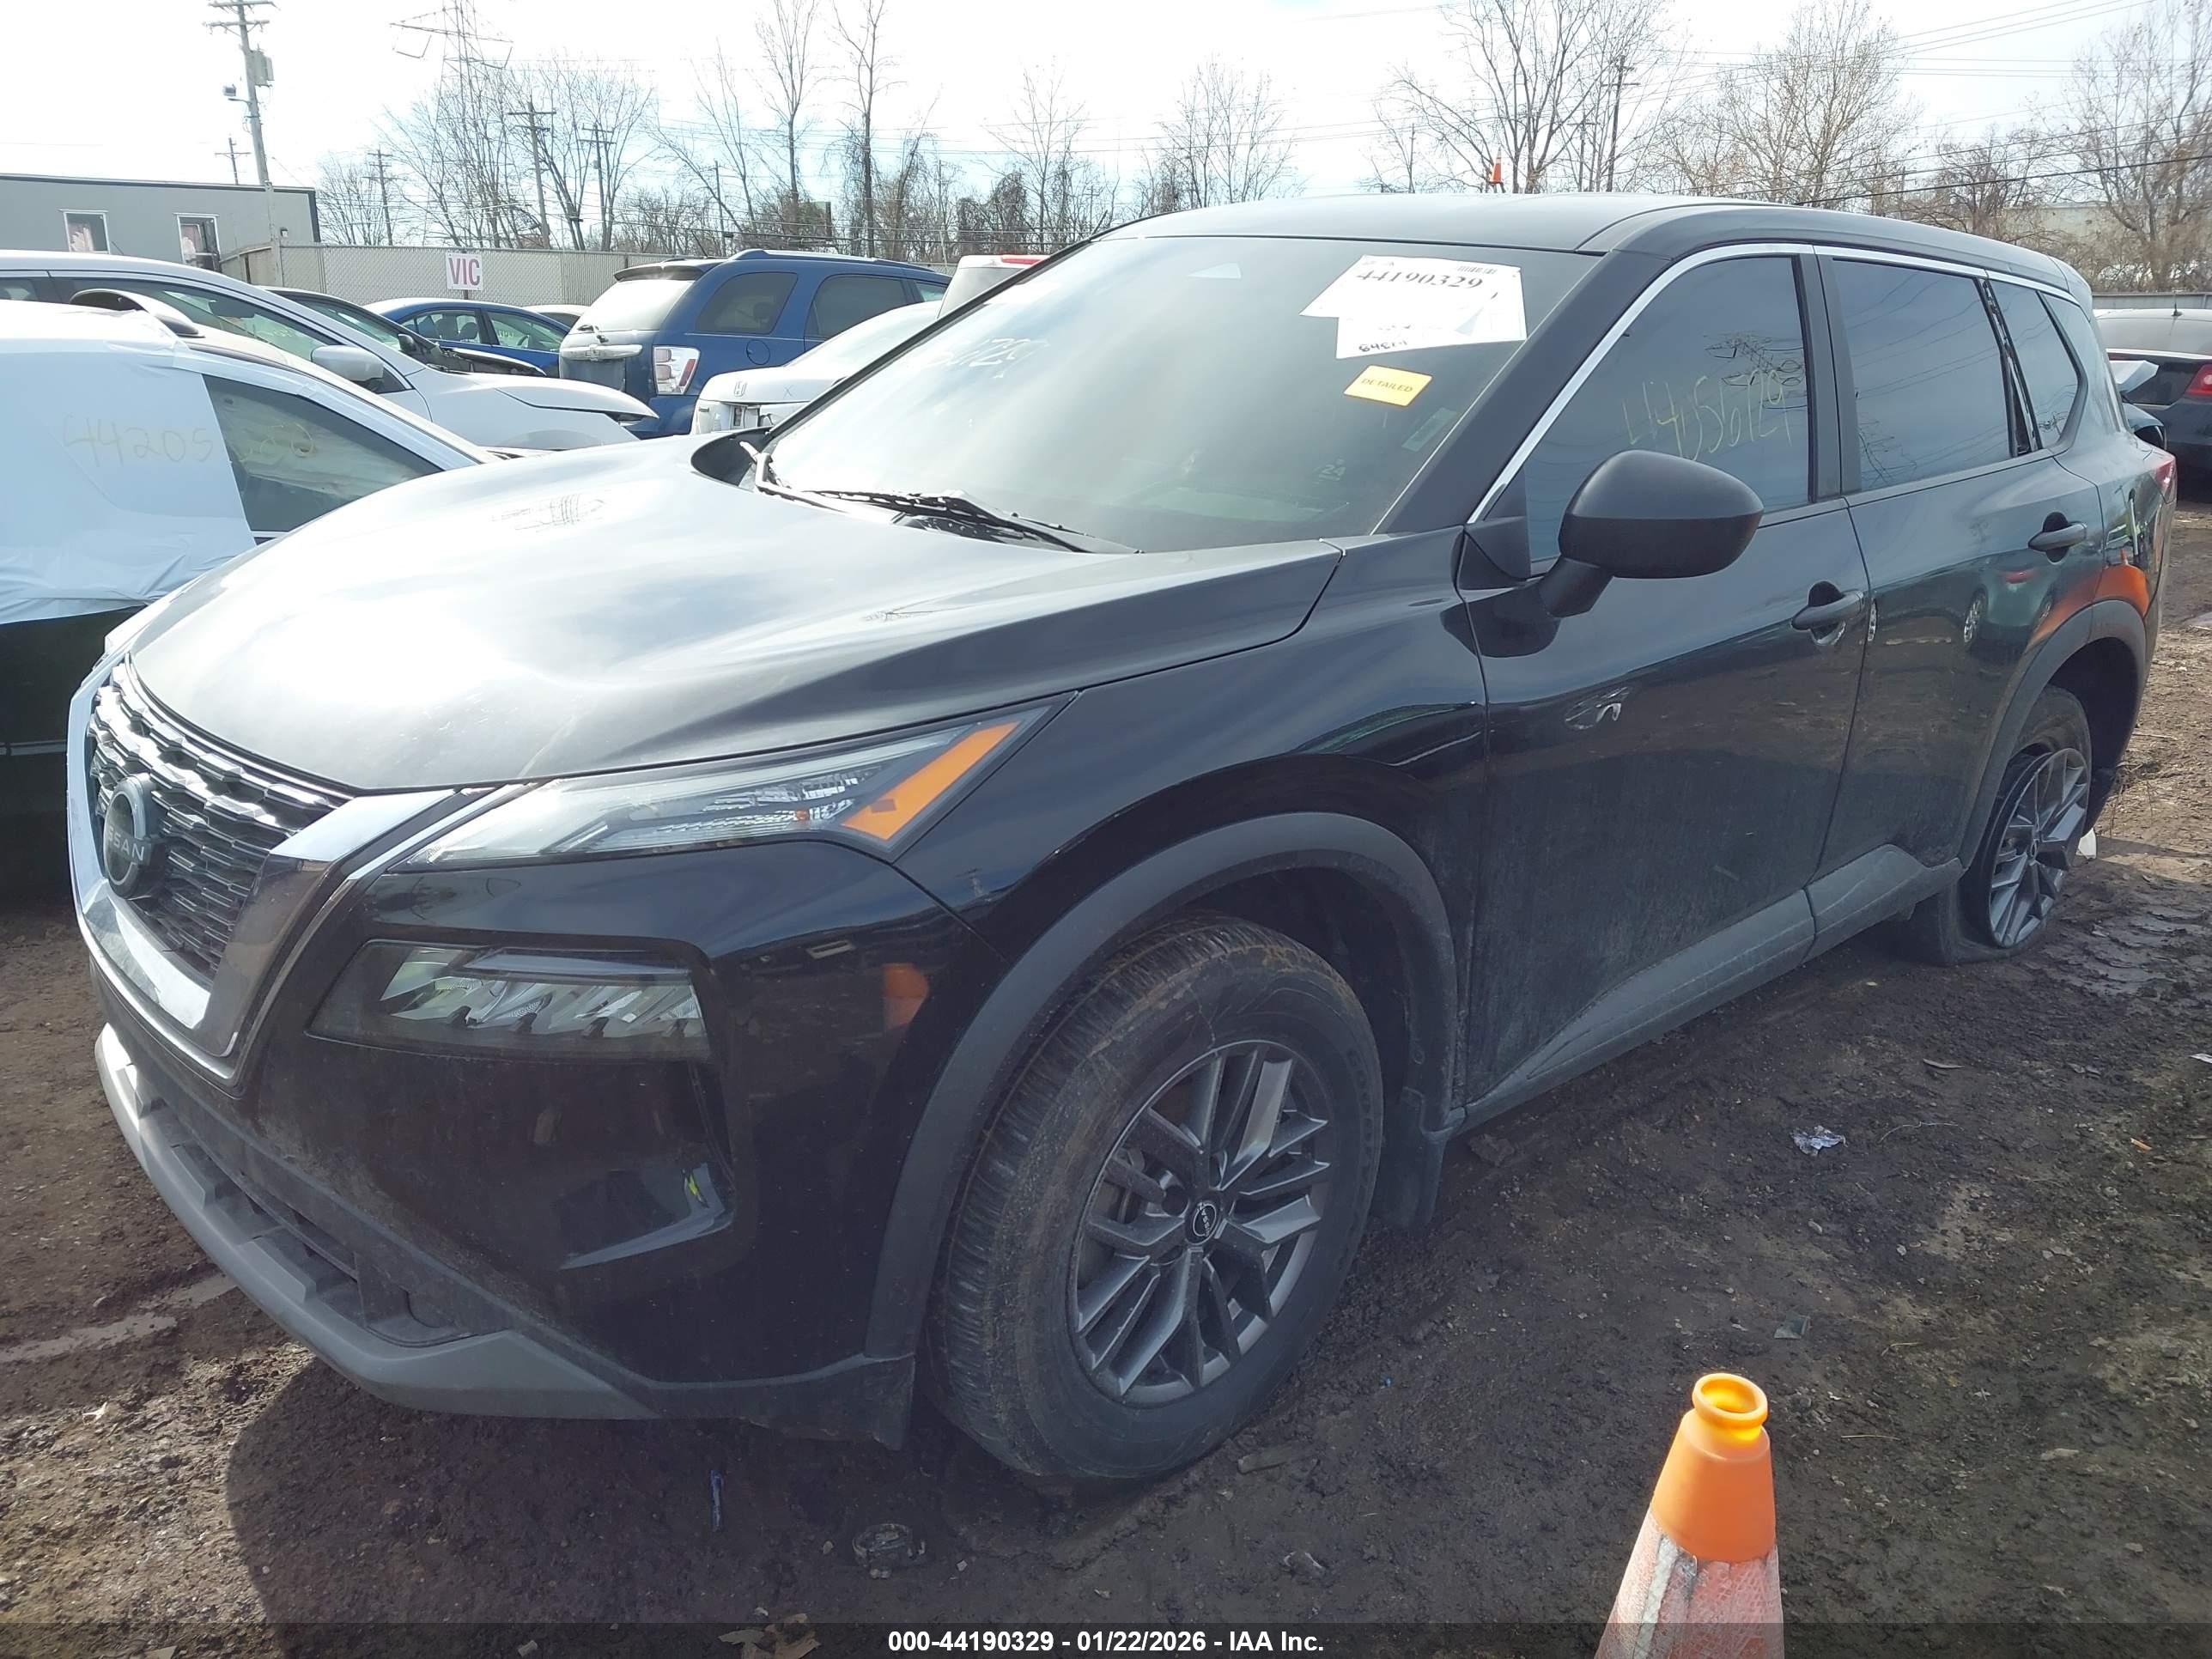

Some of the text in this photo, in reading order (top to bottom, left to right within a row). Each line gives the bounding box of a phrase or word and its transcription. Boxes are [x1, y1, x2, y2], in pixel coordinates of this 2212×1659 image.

[448, 258, 480, 286] VIC
[1356, 269, 1484, 289] 44190329
[1361, 378, 1413, 392] DETAILED
[107, 824, 145, 861] SSAN
